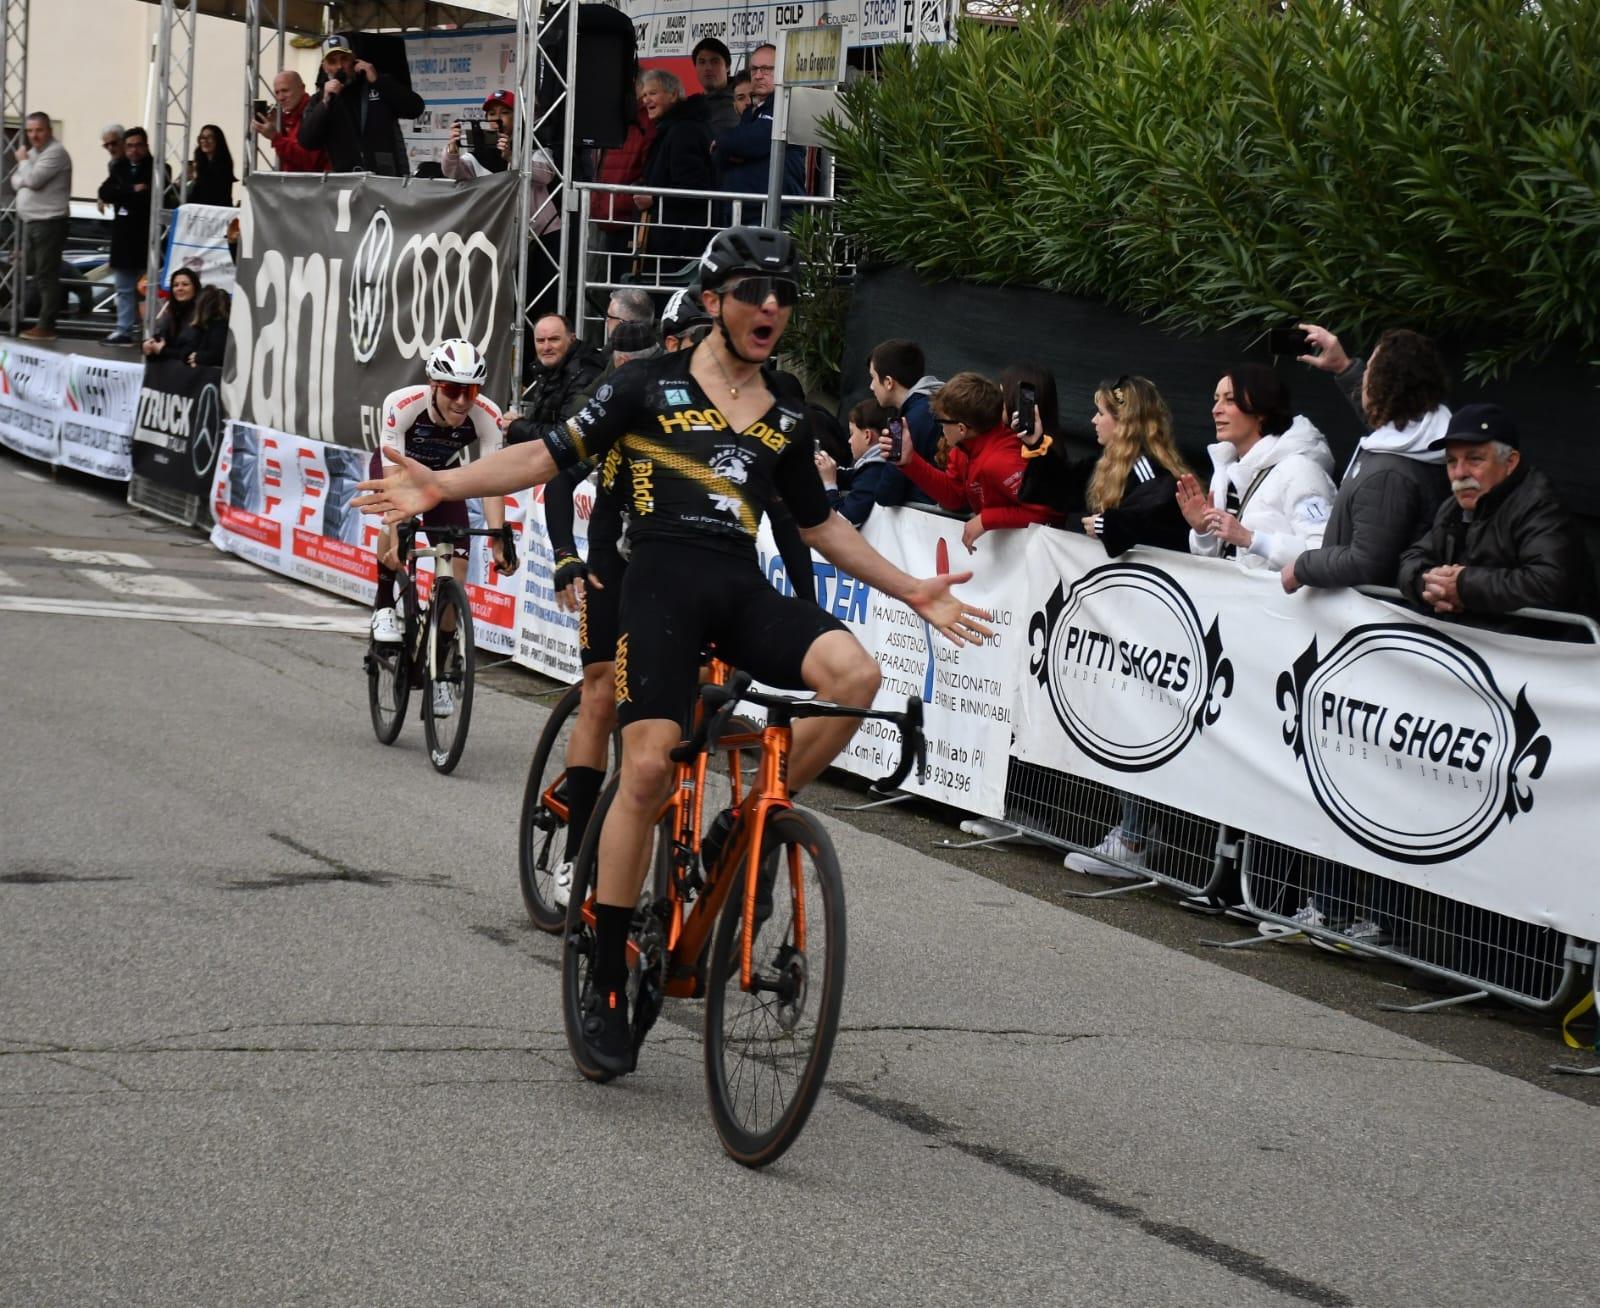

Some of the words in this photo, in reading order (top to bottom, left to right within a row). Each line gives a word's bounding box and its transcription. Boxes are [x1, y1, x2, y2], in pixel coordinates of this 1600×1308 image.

[796, 52, 808, 72] San
[810, 51, 836, 77] Gregorio
[140, 386, 194, 437] TRUCK
[1063, 625, 1115, 672] PITTI
[1118, 639, 1191, 692] SHOES
[1062, 664, 1098, 685] MADE
[1111, 678, 1129, 692] IN
[1141, 685, 1182, 709] ITALY
[1321, 690, 1389, 747] PITTI
[1388, 712, 1493, 773] SHOES
[1321, 735, 1369, 760] MADE
[1384, 754, 1403, 770] IN
[1420, 764, 1484, 793] ITALY
